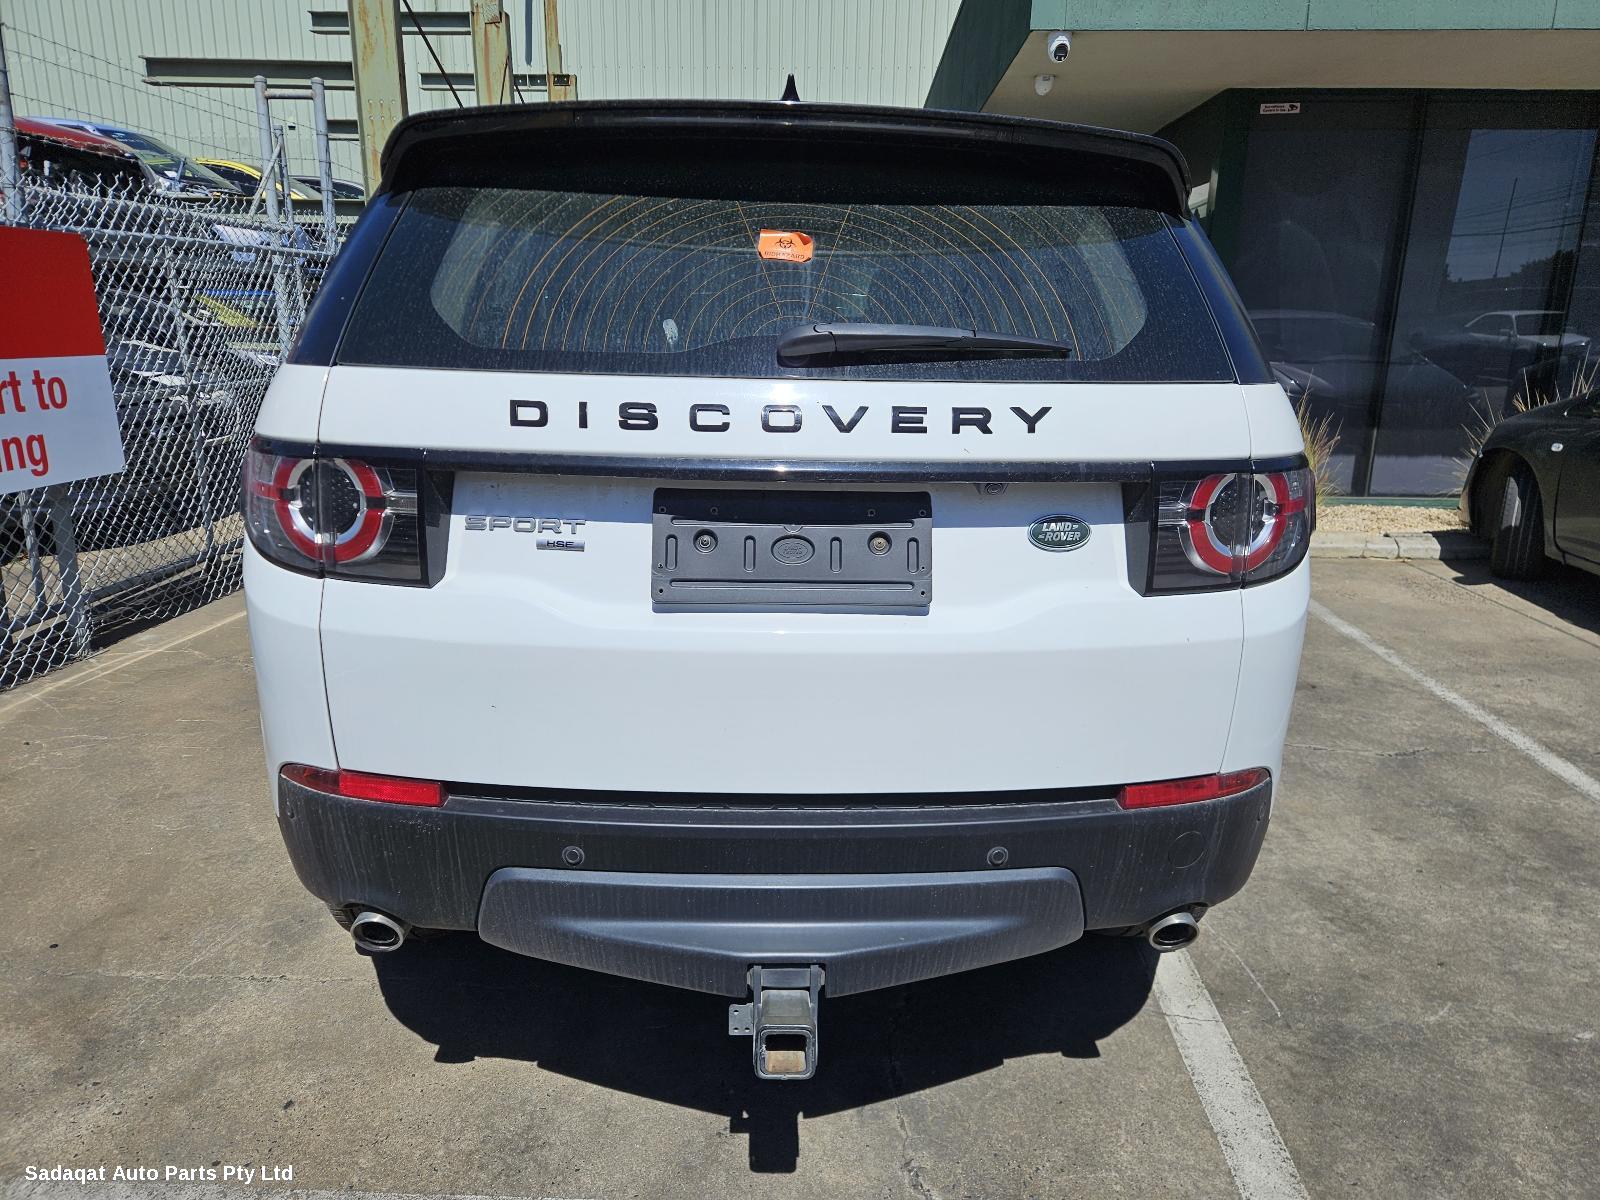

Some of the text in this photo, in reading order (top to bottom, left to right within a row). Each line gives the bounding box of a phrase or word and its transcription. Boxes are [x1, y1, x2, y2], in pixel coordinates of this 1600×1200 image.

[32, 370, 68, 410] to
[509, 399, 1053, 435] DISCOVERY
[0, 433, 49, 477] ng
[465, 514, 586, 535] SPORT
[1042, 521, 1073, 532] LAND
[546, 540, 575, 548] HSE
[1044, 531, 1081, 541] ROVER
